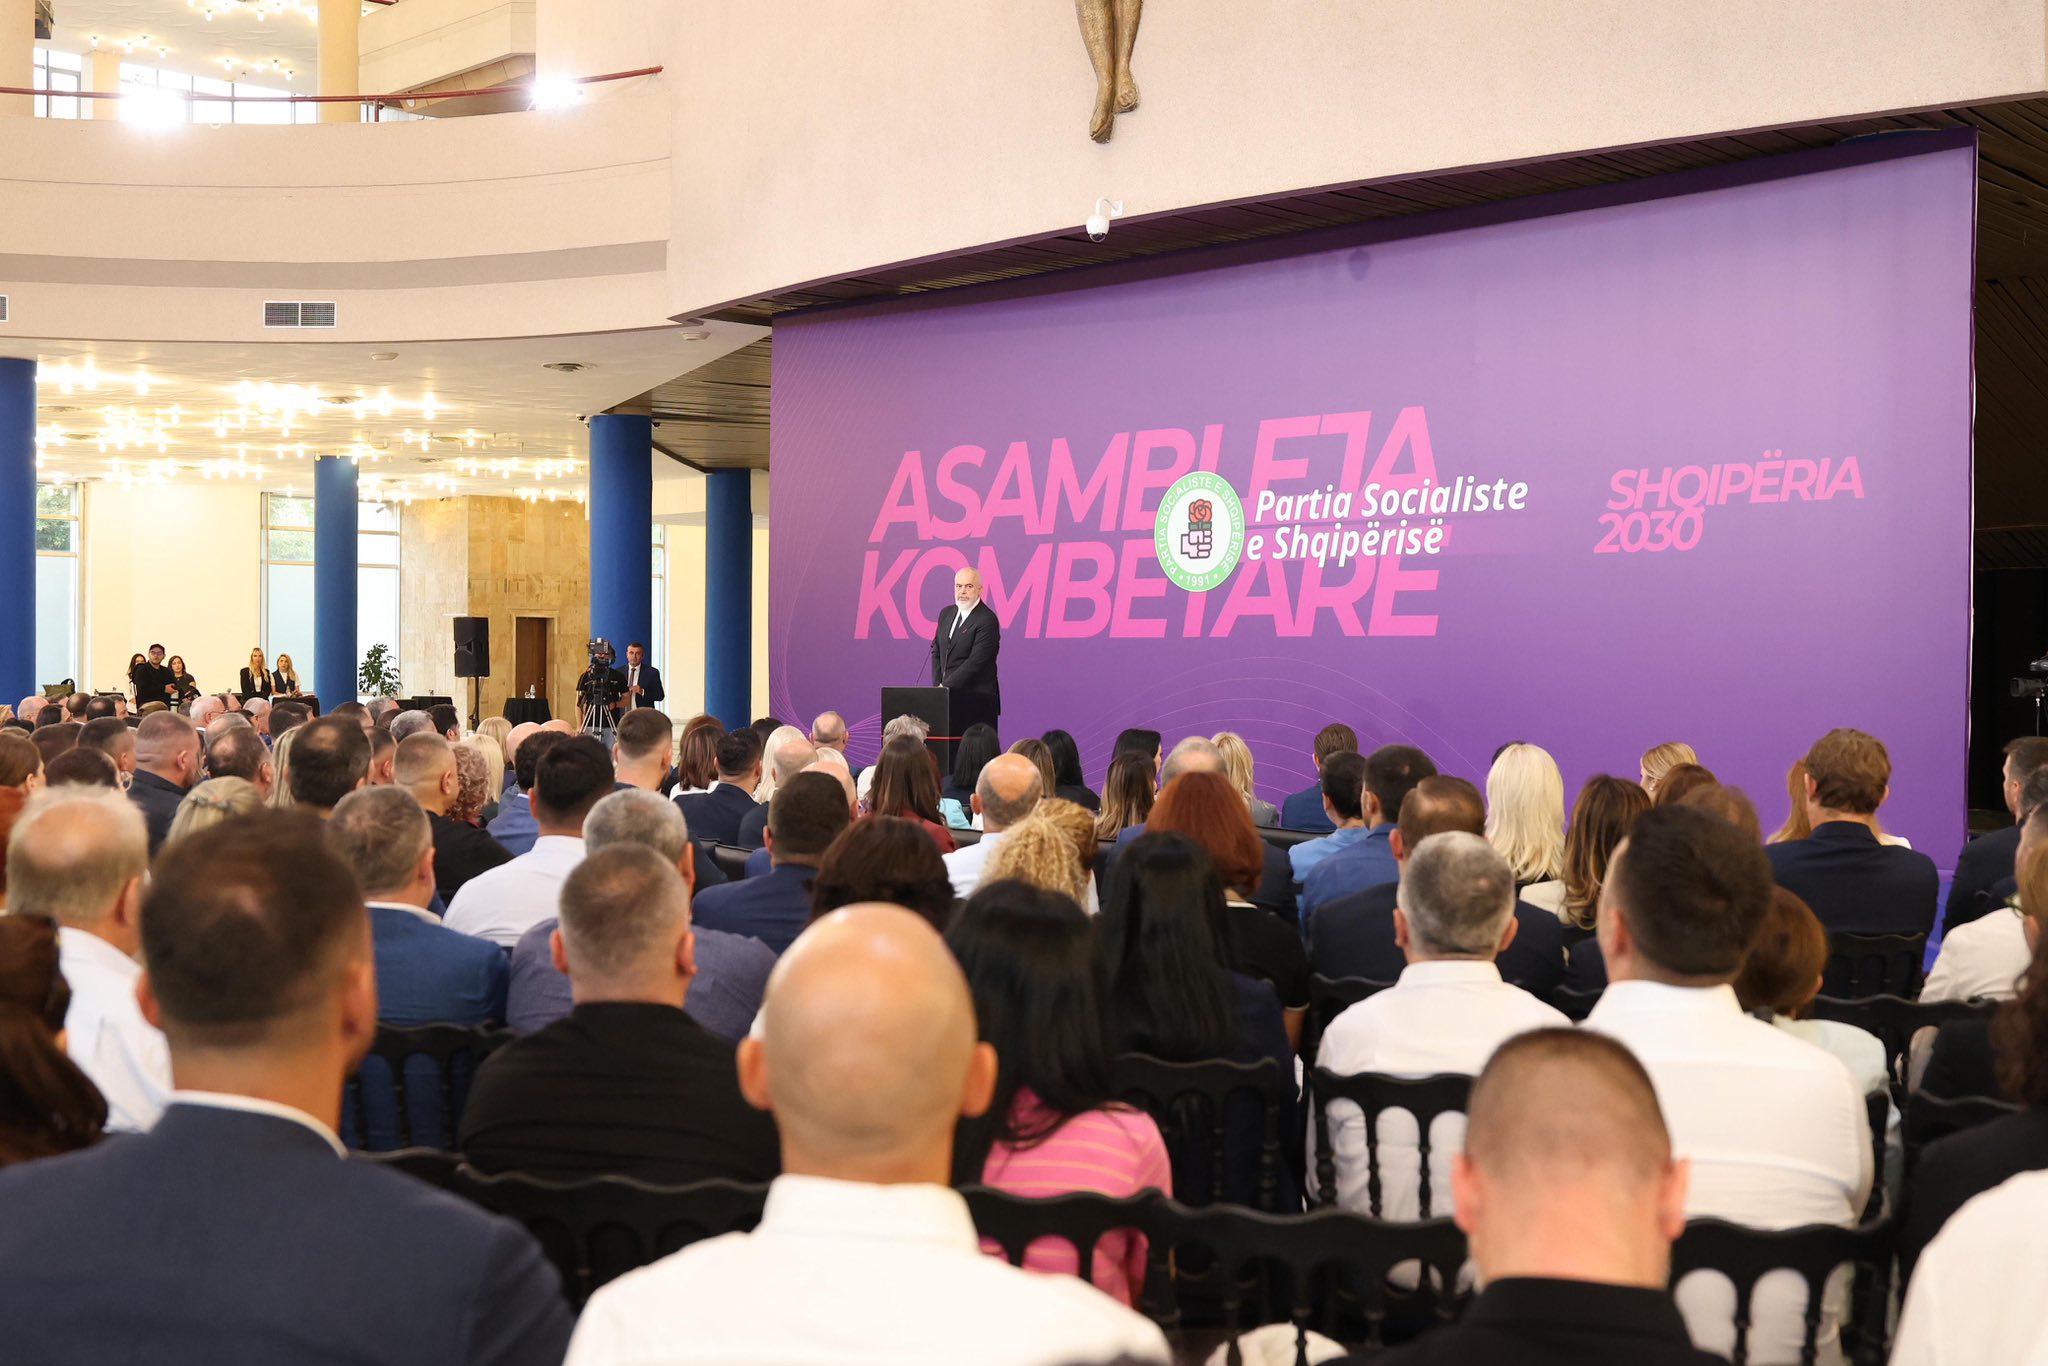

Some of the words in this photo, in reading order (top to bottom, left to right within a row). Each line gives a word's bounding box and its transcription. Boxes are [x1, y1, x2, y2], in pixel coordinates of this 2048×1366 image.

[1160, 476, 1213, 523] SOCIALISTE
[1214, 481, 1223, 494] E
[1255, 484, 1352, 522] Partia
[1361, 475, 1529, 517] Socialiste
[1606, 449, 1865, 511] SHQIPËRIA
[1158, 527, 1178, 575] PARTIA
[1246, 534, 1264, 560] e
[1272, 518, 1444, 568] Shqipërisë
[1593, 509, 1704, 553] 2030
[1186, 575, 1210, 587] 1991
